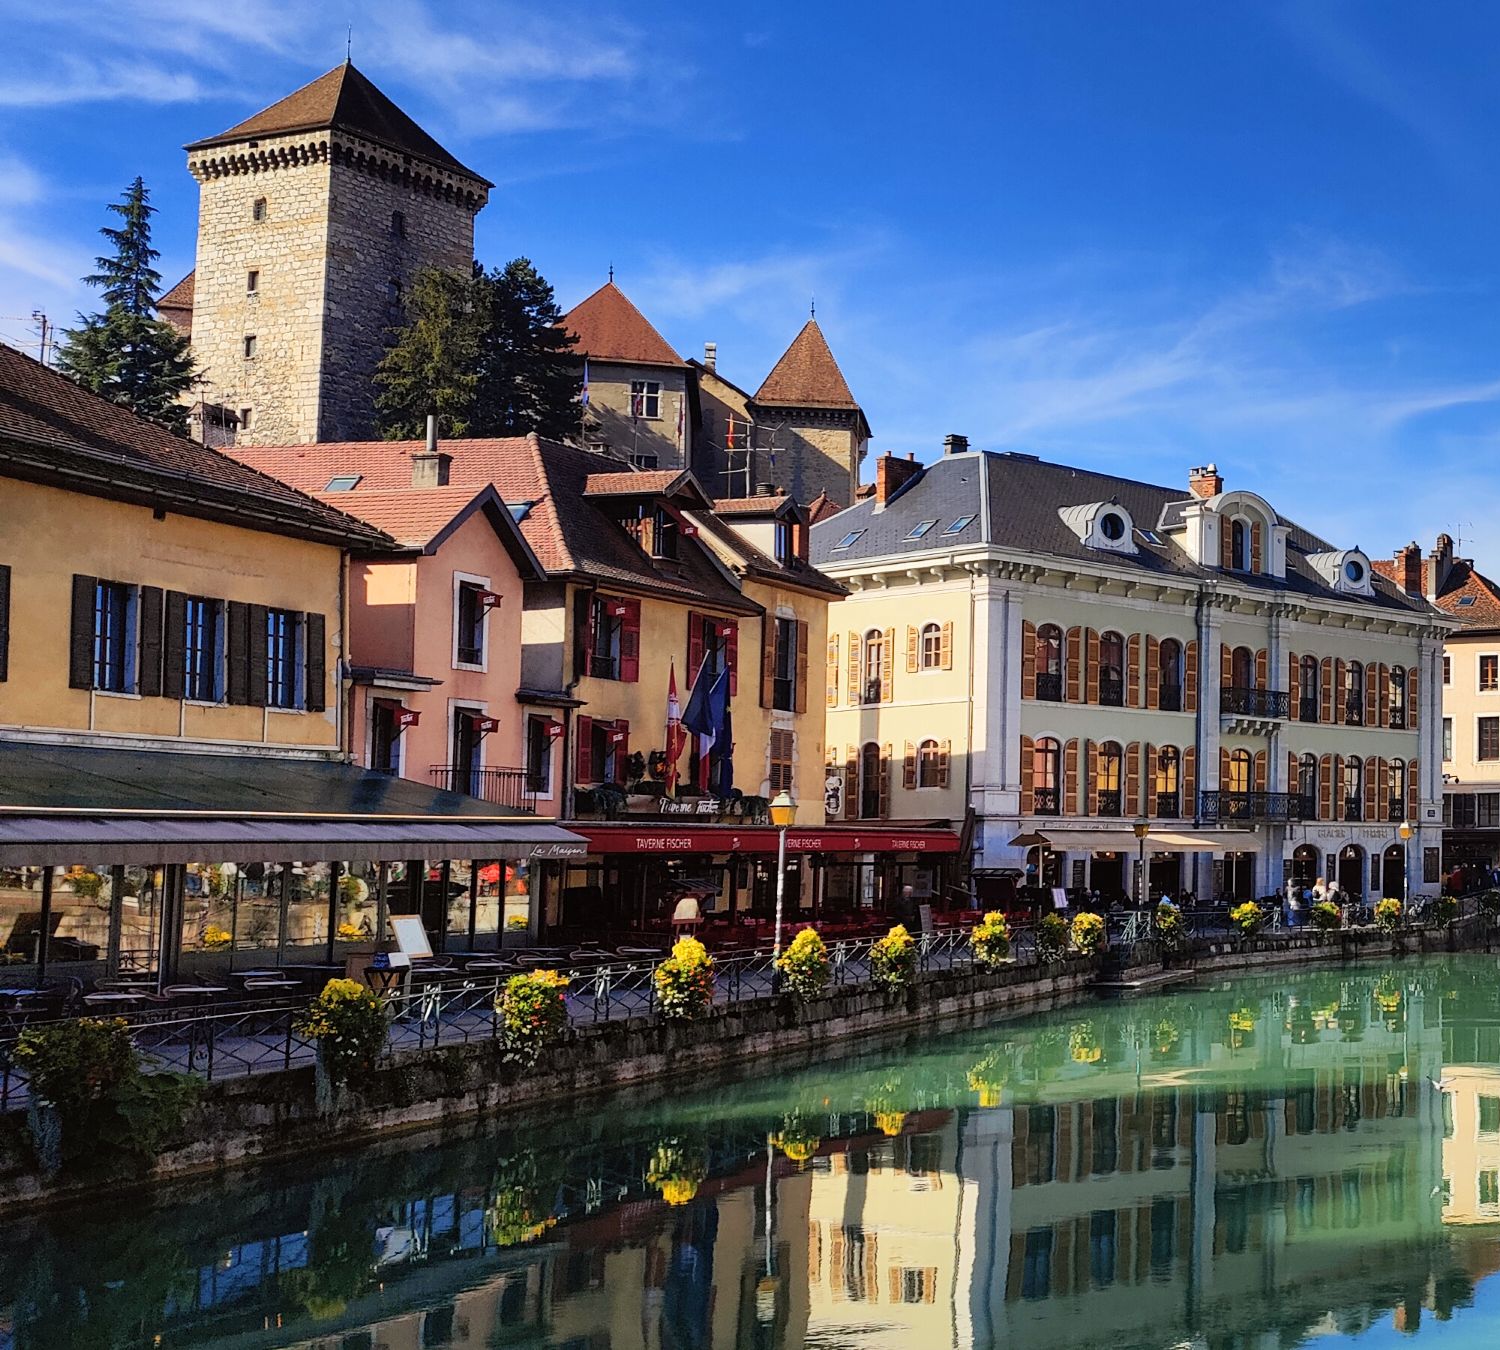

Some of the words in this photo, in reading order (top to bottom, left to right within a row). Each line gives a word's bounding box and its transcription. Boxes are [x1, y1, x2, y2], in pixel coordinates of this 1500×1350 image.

[636, 838, 665, 849] TAVERNE
[666, 838, 692, 849] FISCHER
[802, 838, 822, 848] FISCHER
[529, 844, 545, 857] La
[548, 844, 586, 856] Maison
